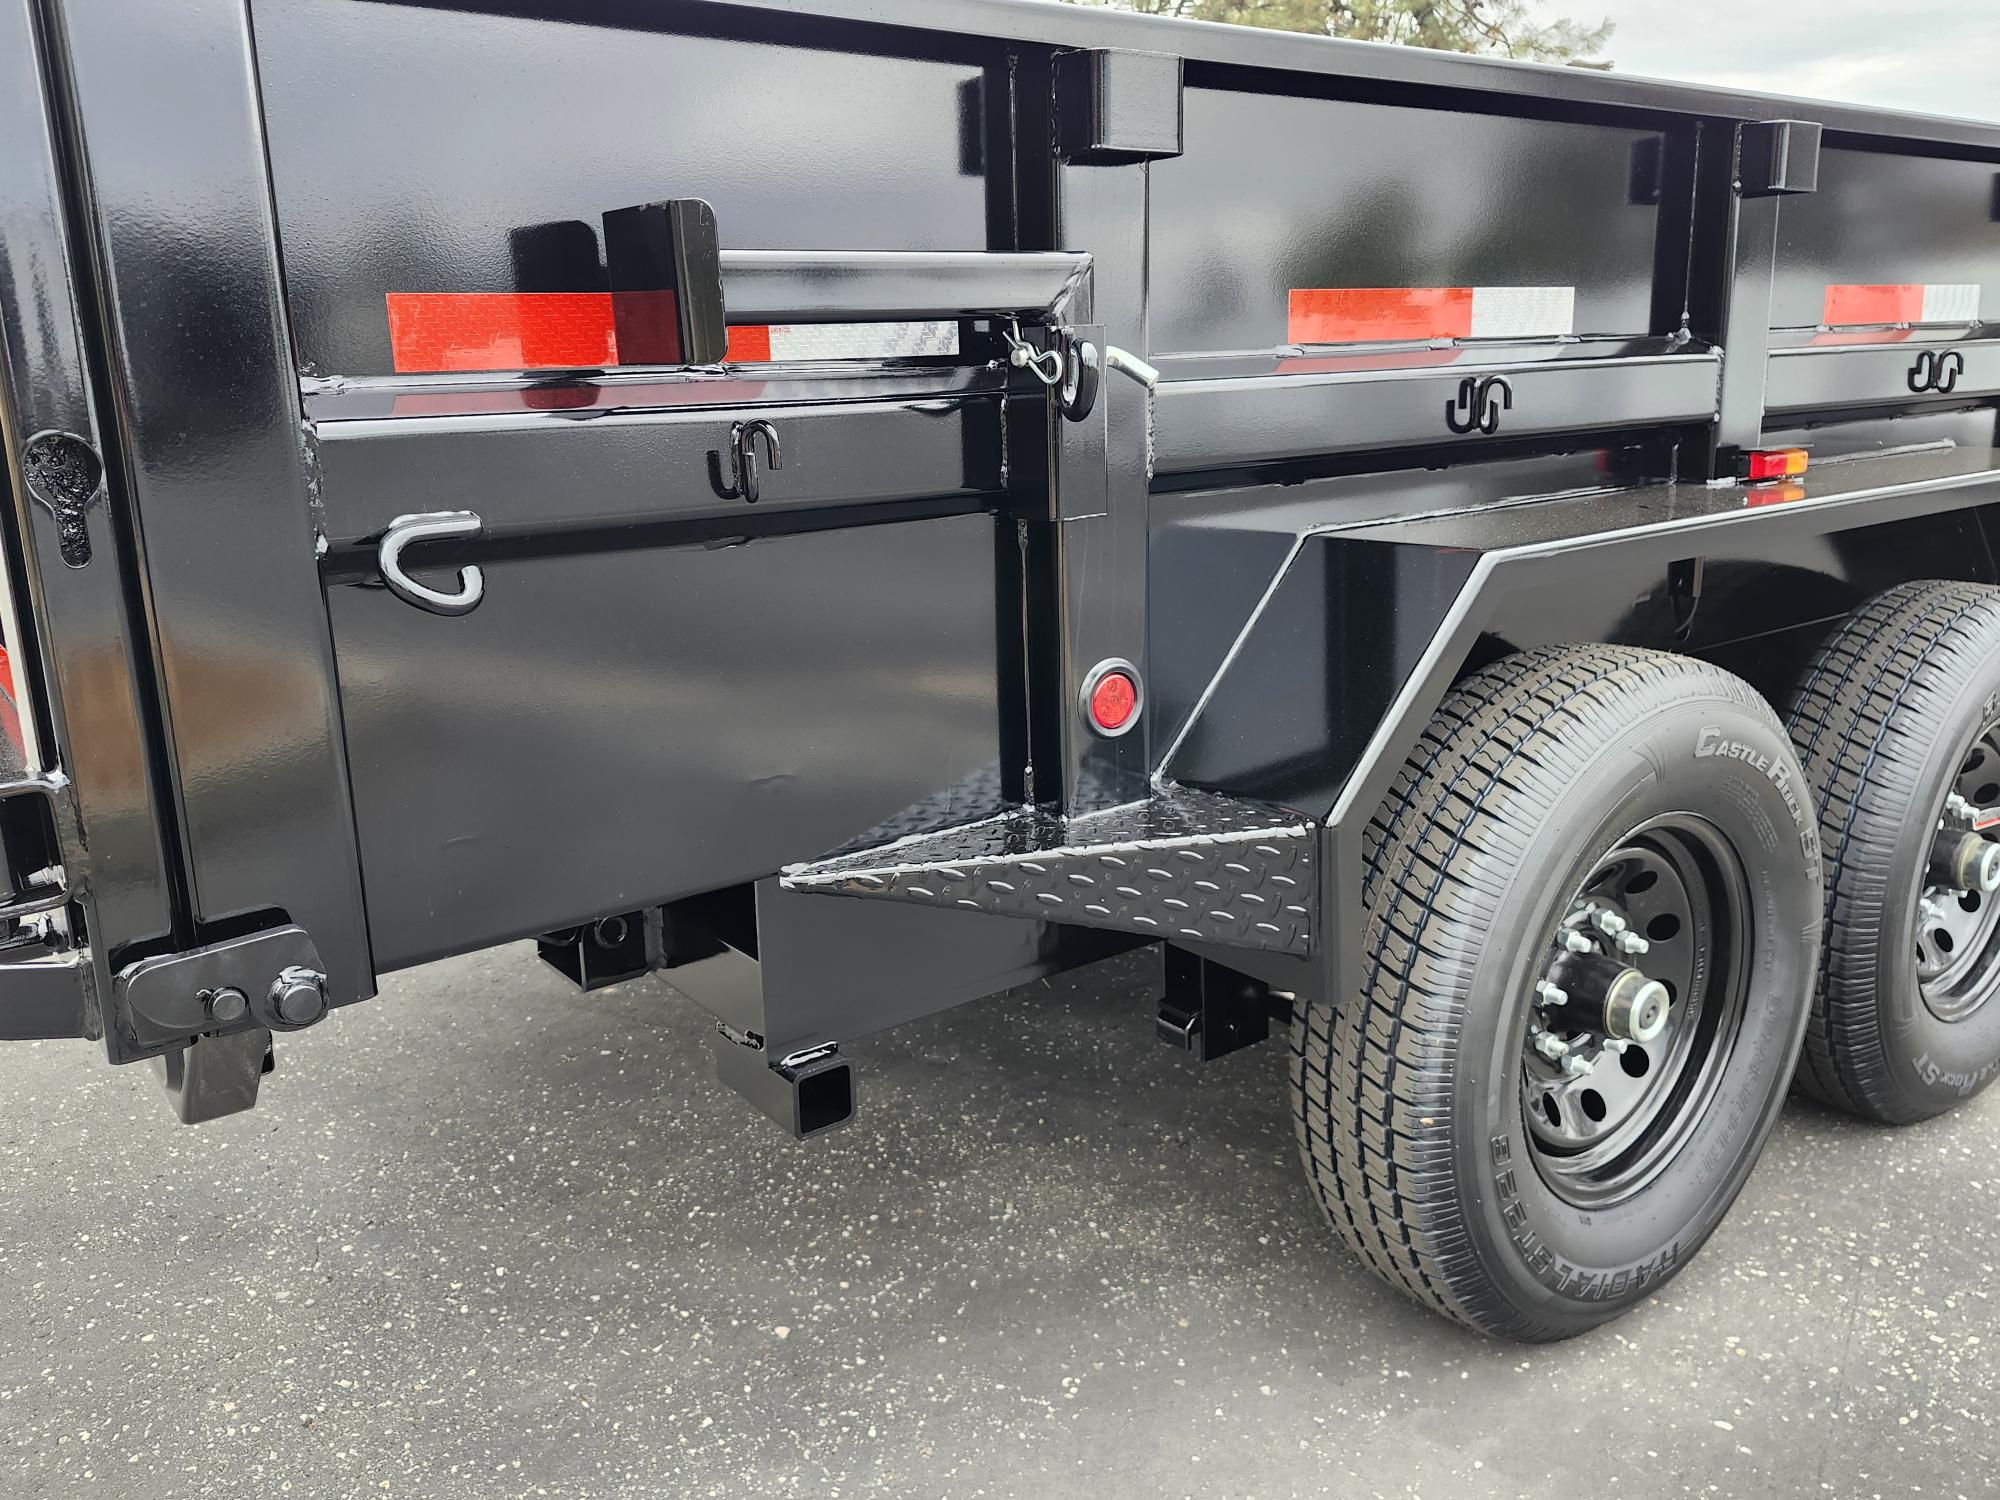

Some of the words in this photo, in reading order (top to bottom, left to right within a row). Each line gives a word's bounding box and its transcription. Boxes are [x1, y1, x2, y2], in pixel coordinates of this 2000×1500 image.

[1799, 826, 1822, 886] ST
[1911, 1051, 1941, 1086] ST
[1556, 1240, 1680, 1302] RADIAL
